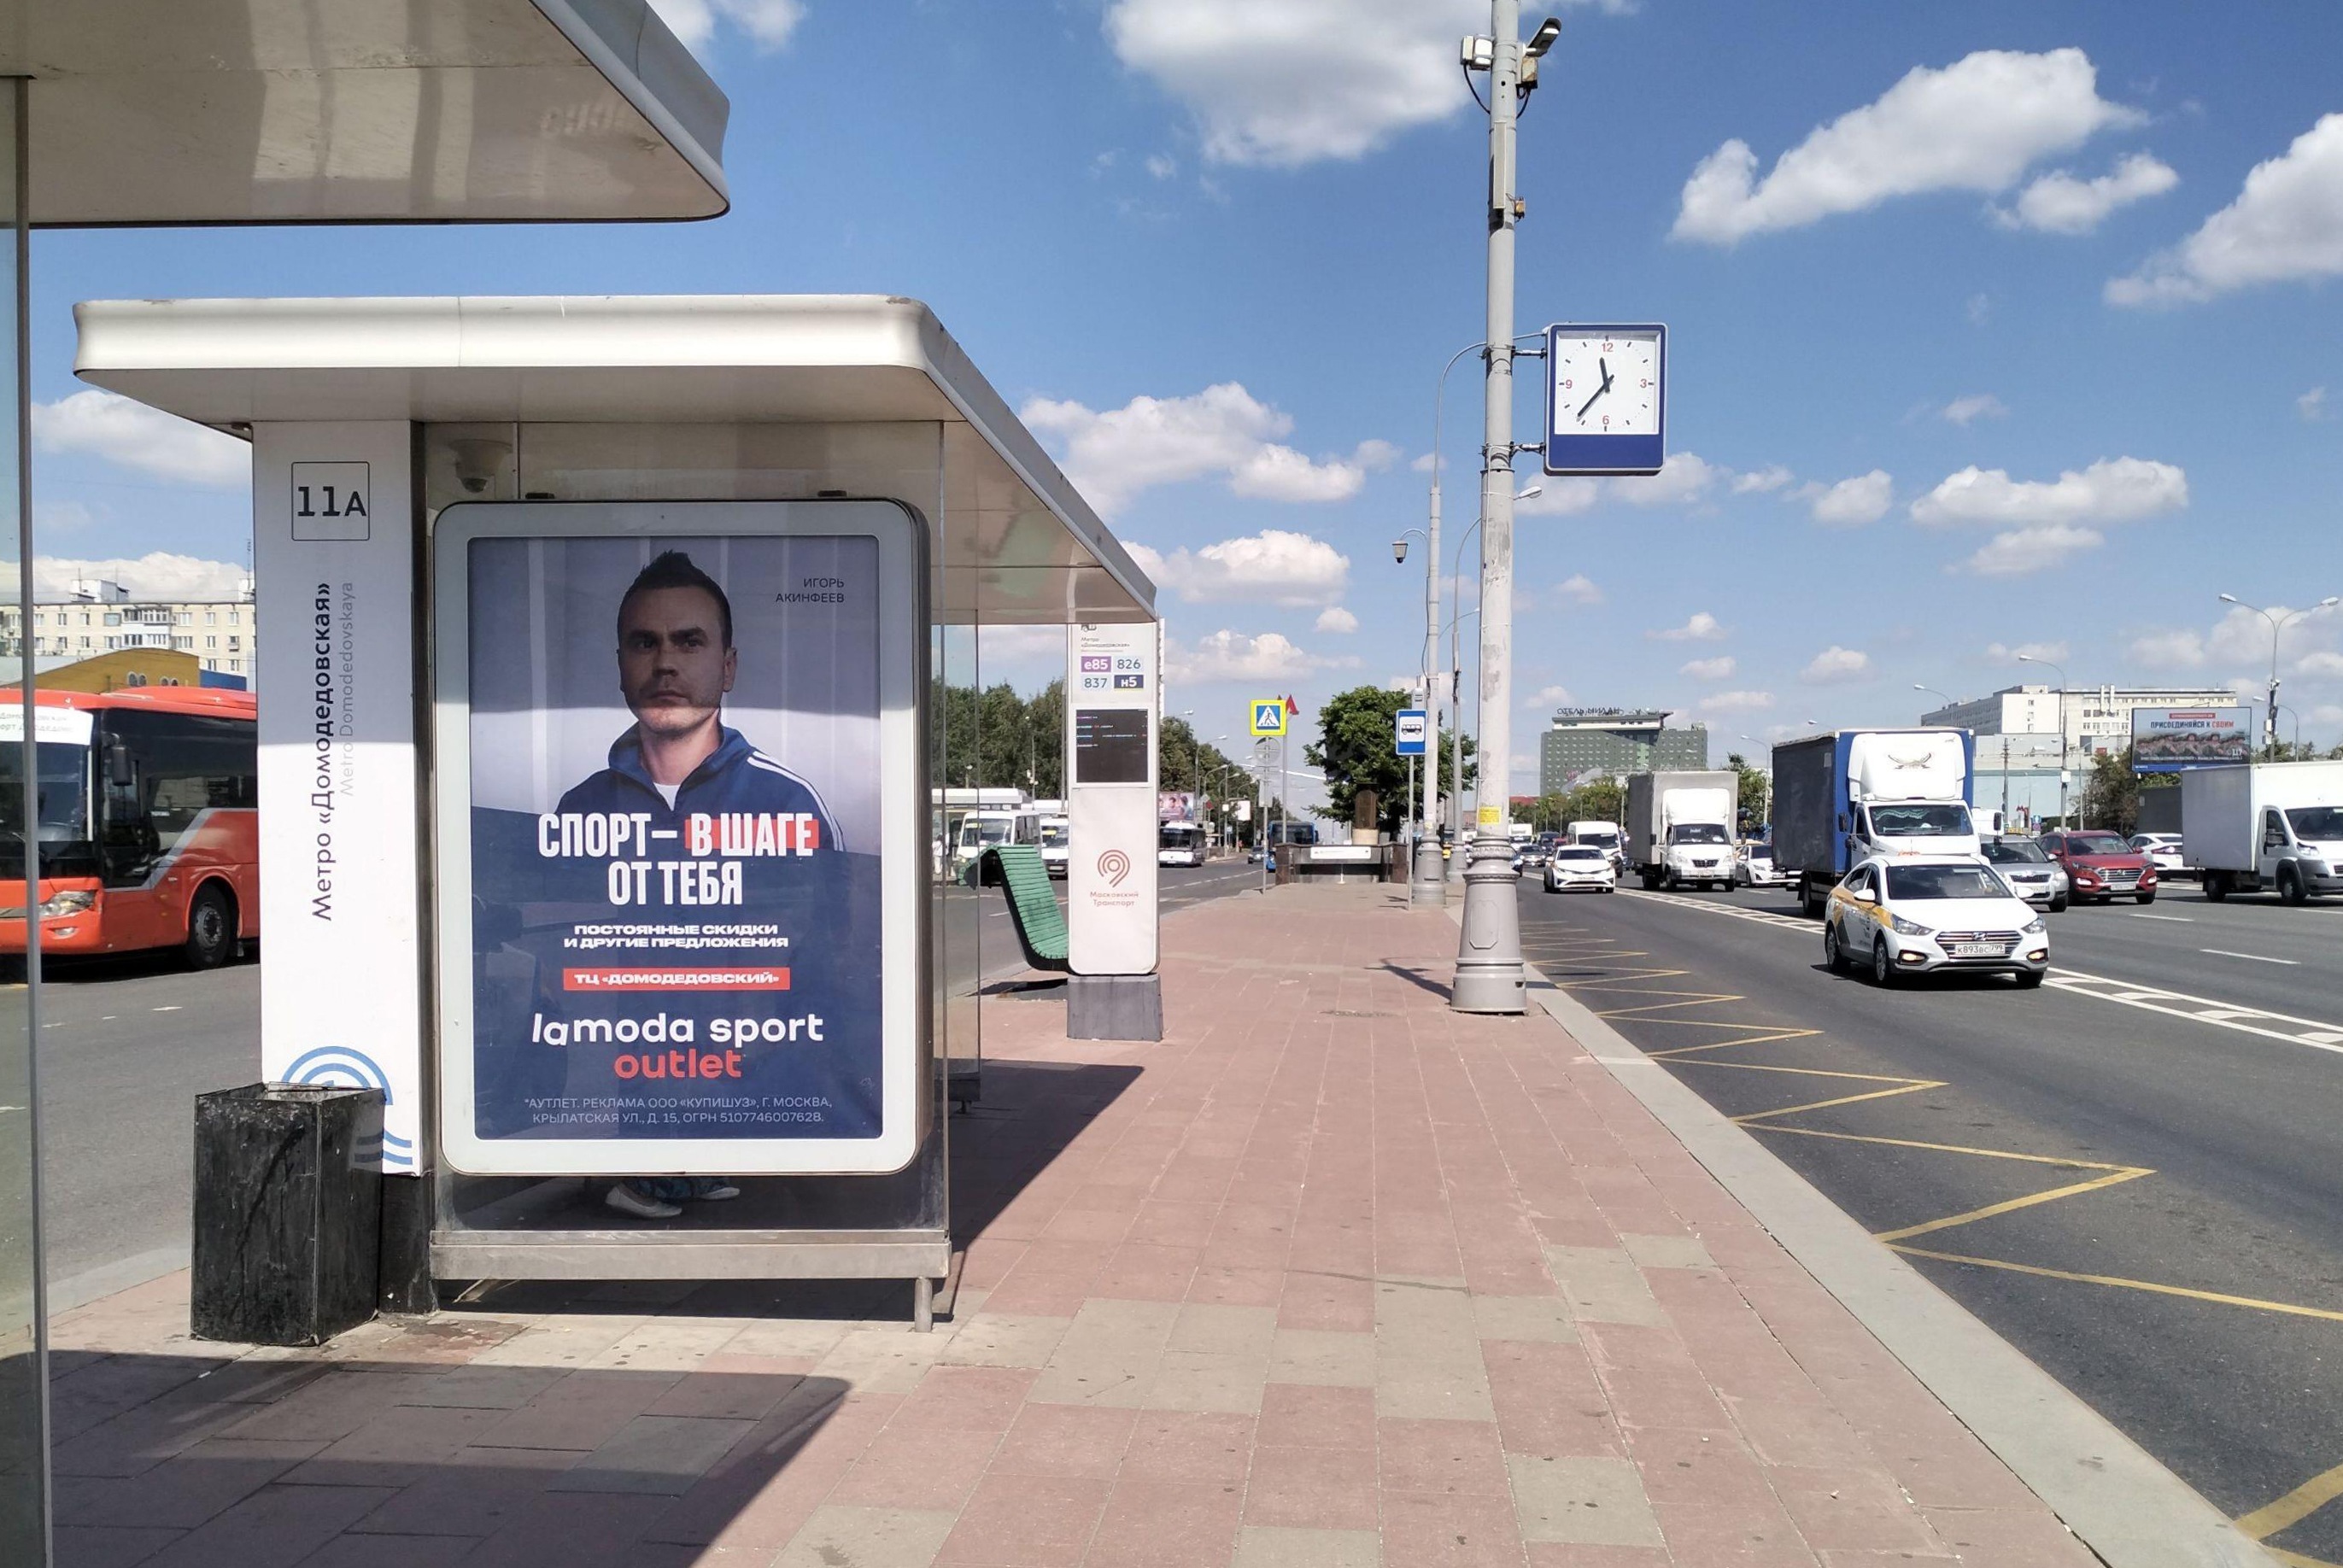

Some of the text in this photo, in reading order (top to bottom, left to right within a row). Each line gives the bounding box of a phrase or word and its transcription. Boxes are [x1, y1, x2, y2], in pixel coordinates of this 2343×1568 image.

[1602, 343, 1614, 353] 12
[1566, 379, 1647, 389] 9 3
[1602, 415, 1609, 424] 6
[803, 578, 845, 588] ИГОРЬ
[776, 593, 845, 603] АКИНФЕЕВ
[1117, 659, 1140, 669] 826
[1084, 678, 1107, 687] 837
[340, 582, 355, 796] Metro Domodedovskaya
[311, 582, 337, 921] Метро «Домодедовская»
[691, 813, 712, 857] В
[720, 813, 813, 857] ШАГЕ
[608, 861, 742, 905] ОТ ТЕБЯ
[574, 925, 778, 936] ПОСТОЯННЫЕ СКИДКИ
[564, 937, 788, 949] И ДРУГИЕ ПРЕДЛОЖЕНИЯ
[574, 974, 600, 985] ТЦ
[532, 1013, 823, 1048] lamoda sport
[613, 1049, 741, 1079] outlet
[583, 1098, 646, 1108] РЕКЛАМА
[648, 1098, 677, 1108] ООО
[774, 1097, 832, 1109] МОСКВА,
[533, 1114, 619, 1124] КРЫЛАТСКАЯ
[663, 1113, 680, 1124] 15,
[682, 1113, 717, 1122] ОГРН
[720, 1112, 824, 1123] 5107746007628.
